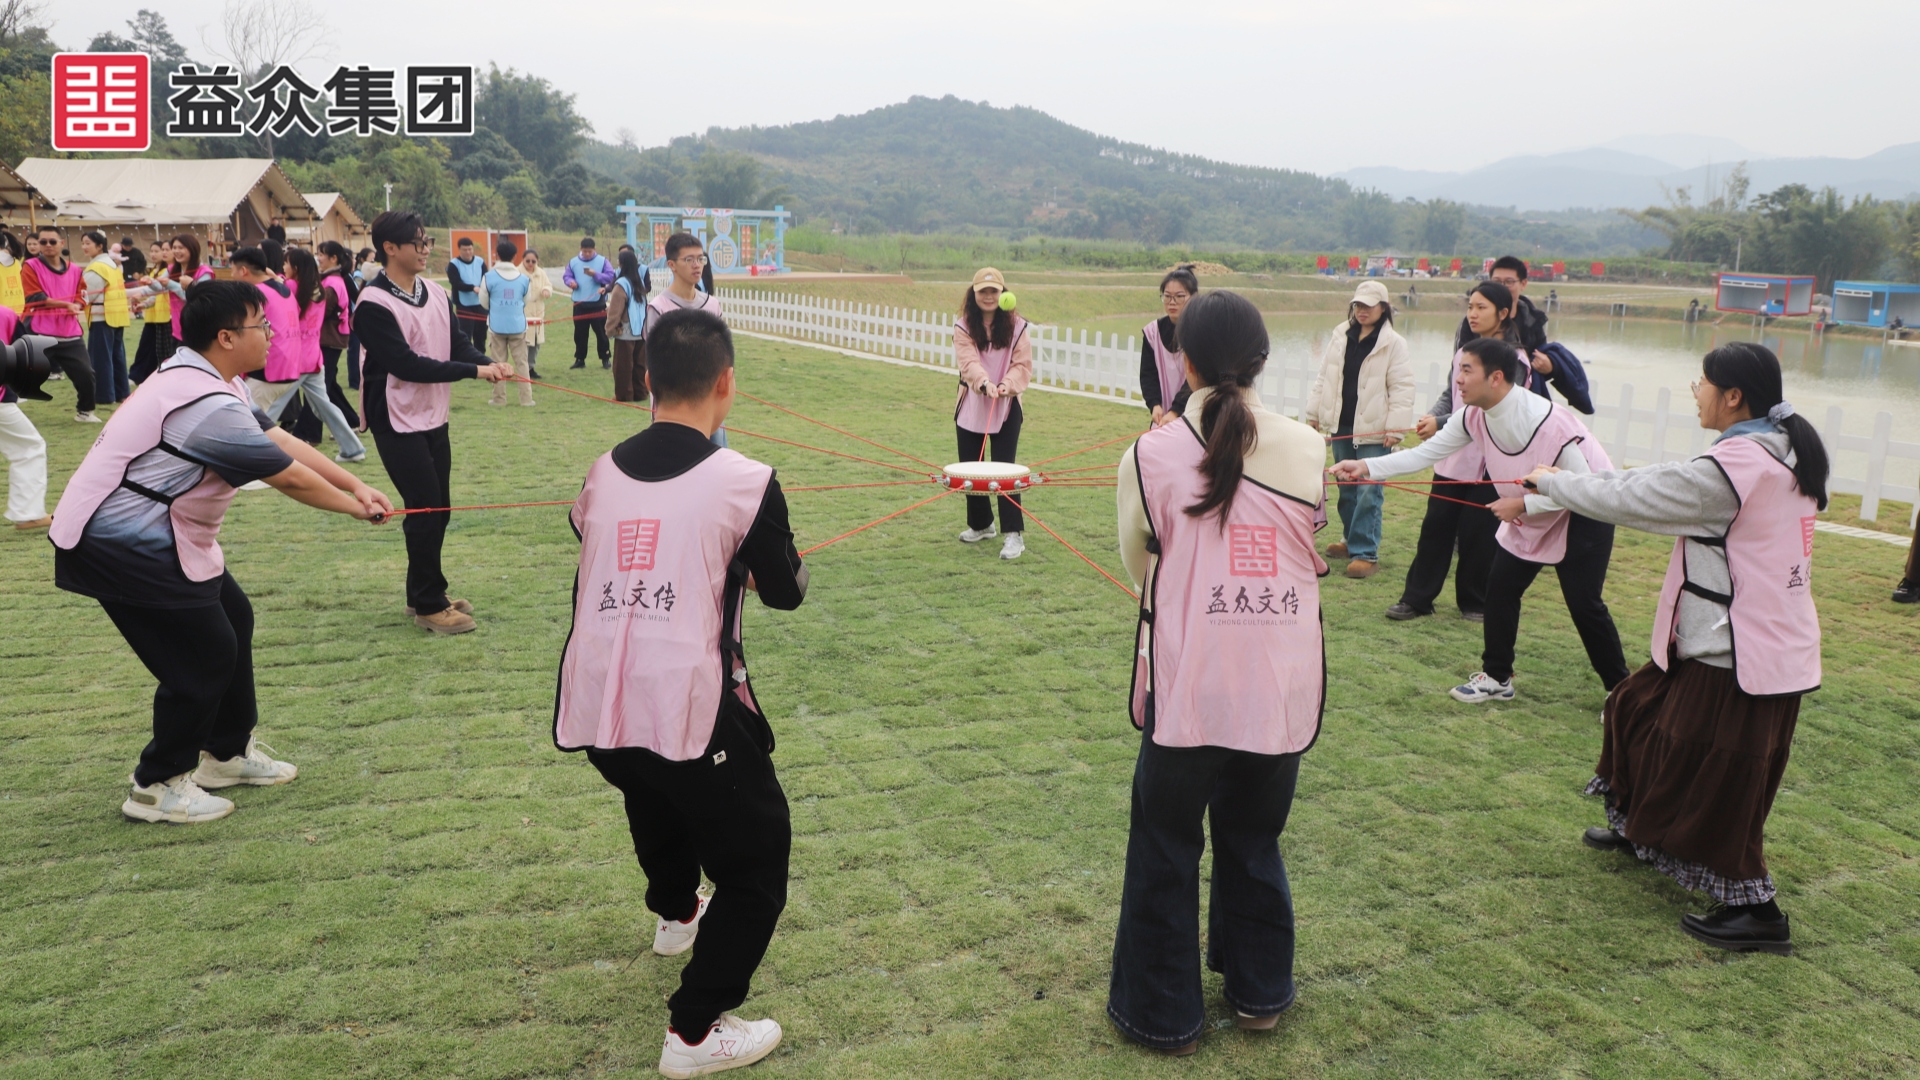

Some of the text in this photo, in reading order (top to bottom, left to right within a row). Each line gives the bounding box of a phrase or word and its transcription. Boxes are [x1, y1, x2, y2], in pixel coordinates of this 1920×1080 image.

[598, 579, 676, 612] 益文传
[1205, 584, 1299, 615] 益众文传
[648, 614, 670, 622] MEDIA
[1280, 618, 1298, 626] MEDIA
